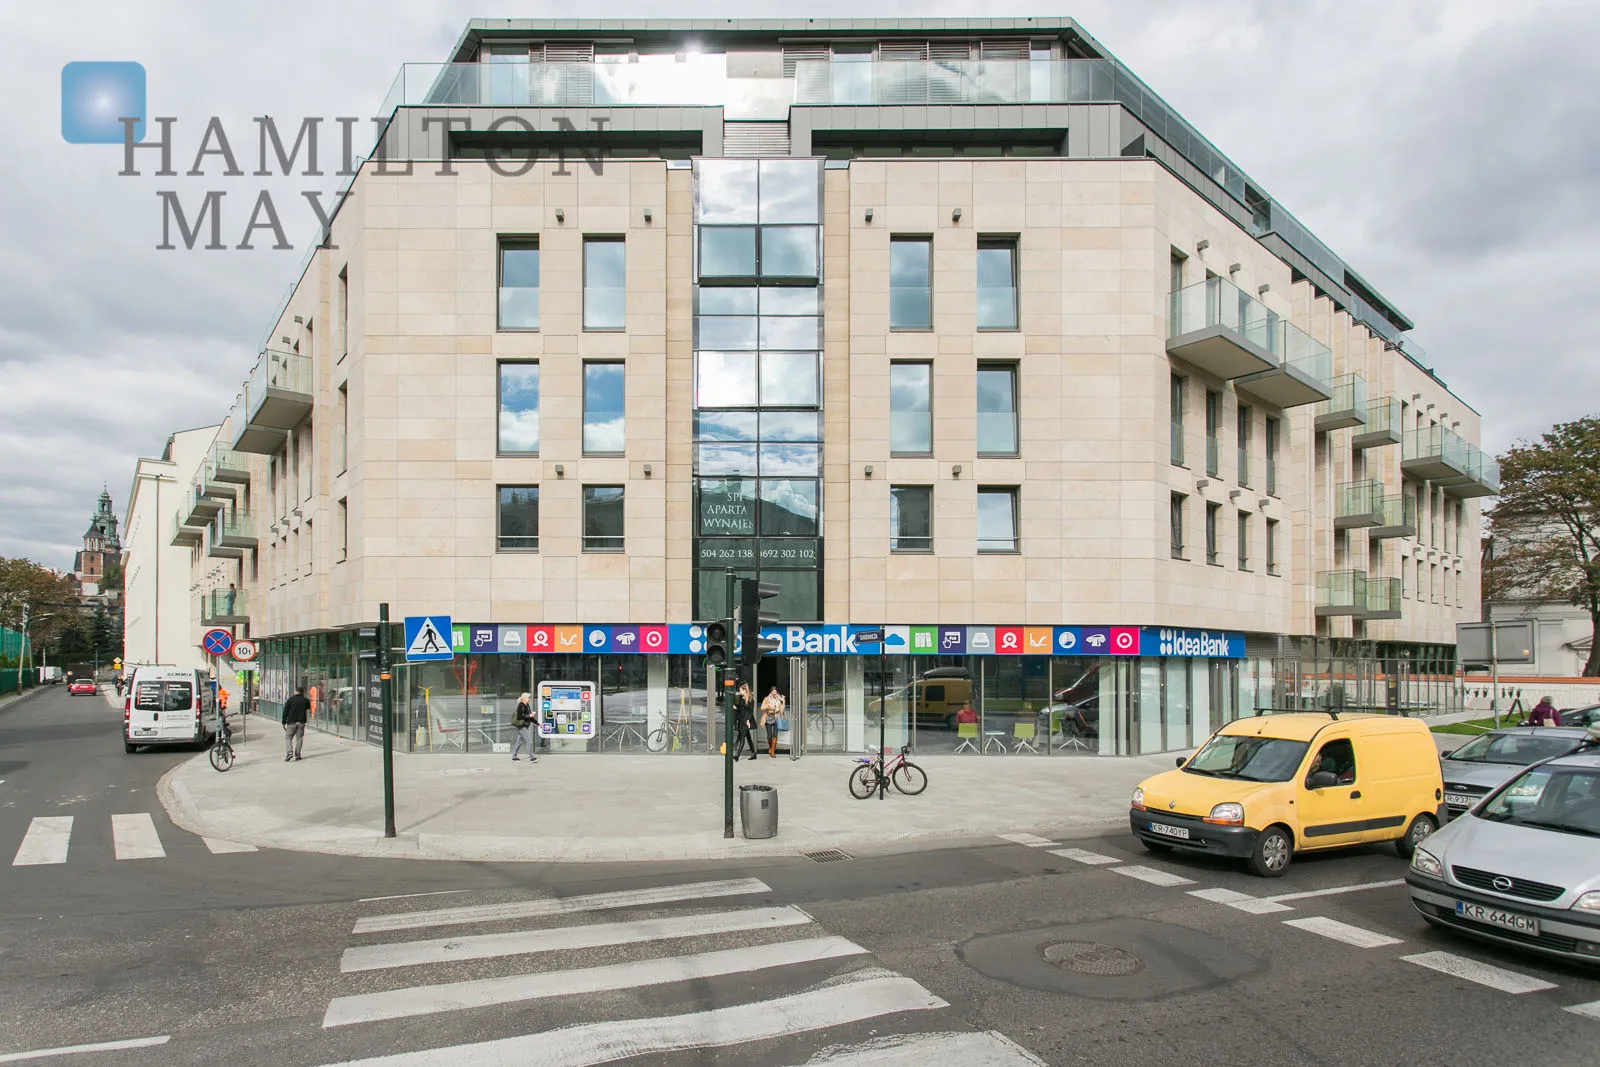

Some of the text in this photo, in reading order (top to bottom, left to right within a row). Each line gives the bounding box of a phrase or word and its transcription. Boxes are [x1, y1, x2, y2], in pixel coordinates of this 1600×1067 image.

[701, 549, 753, 558] 504 262 138
[762, 549, 814, 558] 692 302 102
[1464, 903, 1535, 932] KR 644GM
